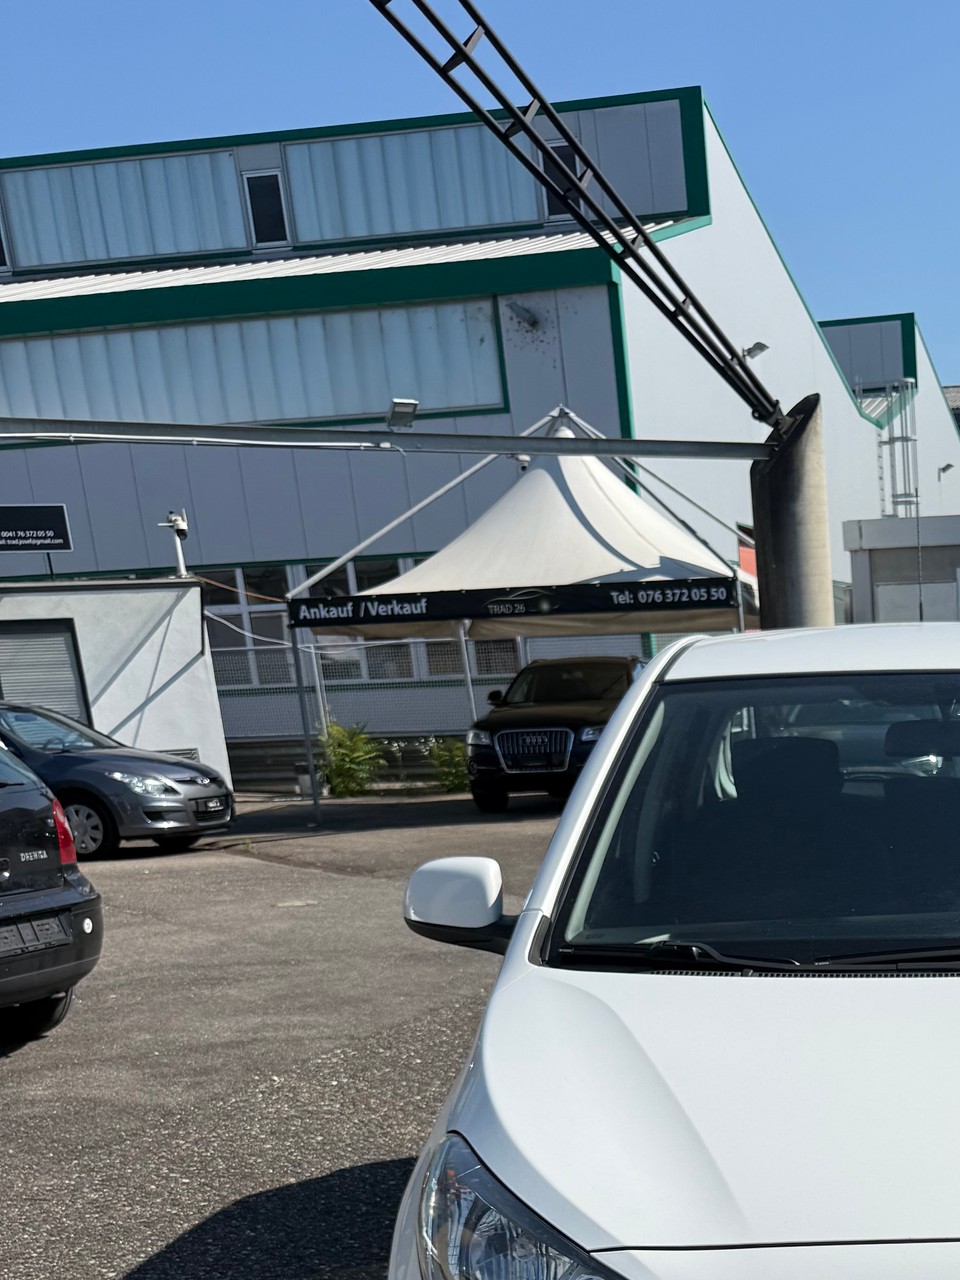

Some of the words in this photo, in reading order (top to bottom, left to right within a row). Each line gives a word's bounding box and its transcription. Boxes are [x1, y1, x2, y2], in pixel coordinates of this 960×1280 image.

[16, 530, 25, 538] 76
[26, 530, 37, 538] 372
[37, 530, 45, 538] 05
[46, 530, 54, 538] 50
[610, 590, 634, 605] Tel:
[637, 589, 663, 604] 076
[665, 588, 690, 603] 372
[691, 588, 708, 601] 05
[710, 587, 727, 600] 50
[300, 601, 354, 620] Ankauf
[487, 603, 513, 615] TRAD
[514, 603, 526, 614] 26
